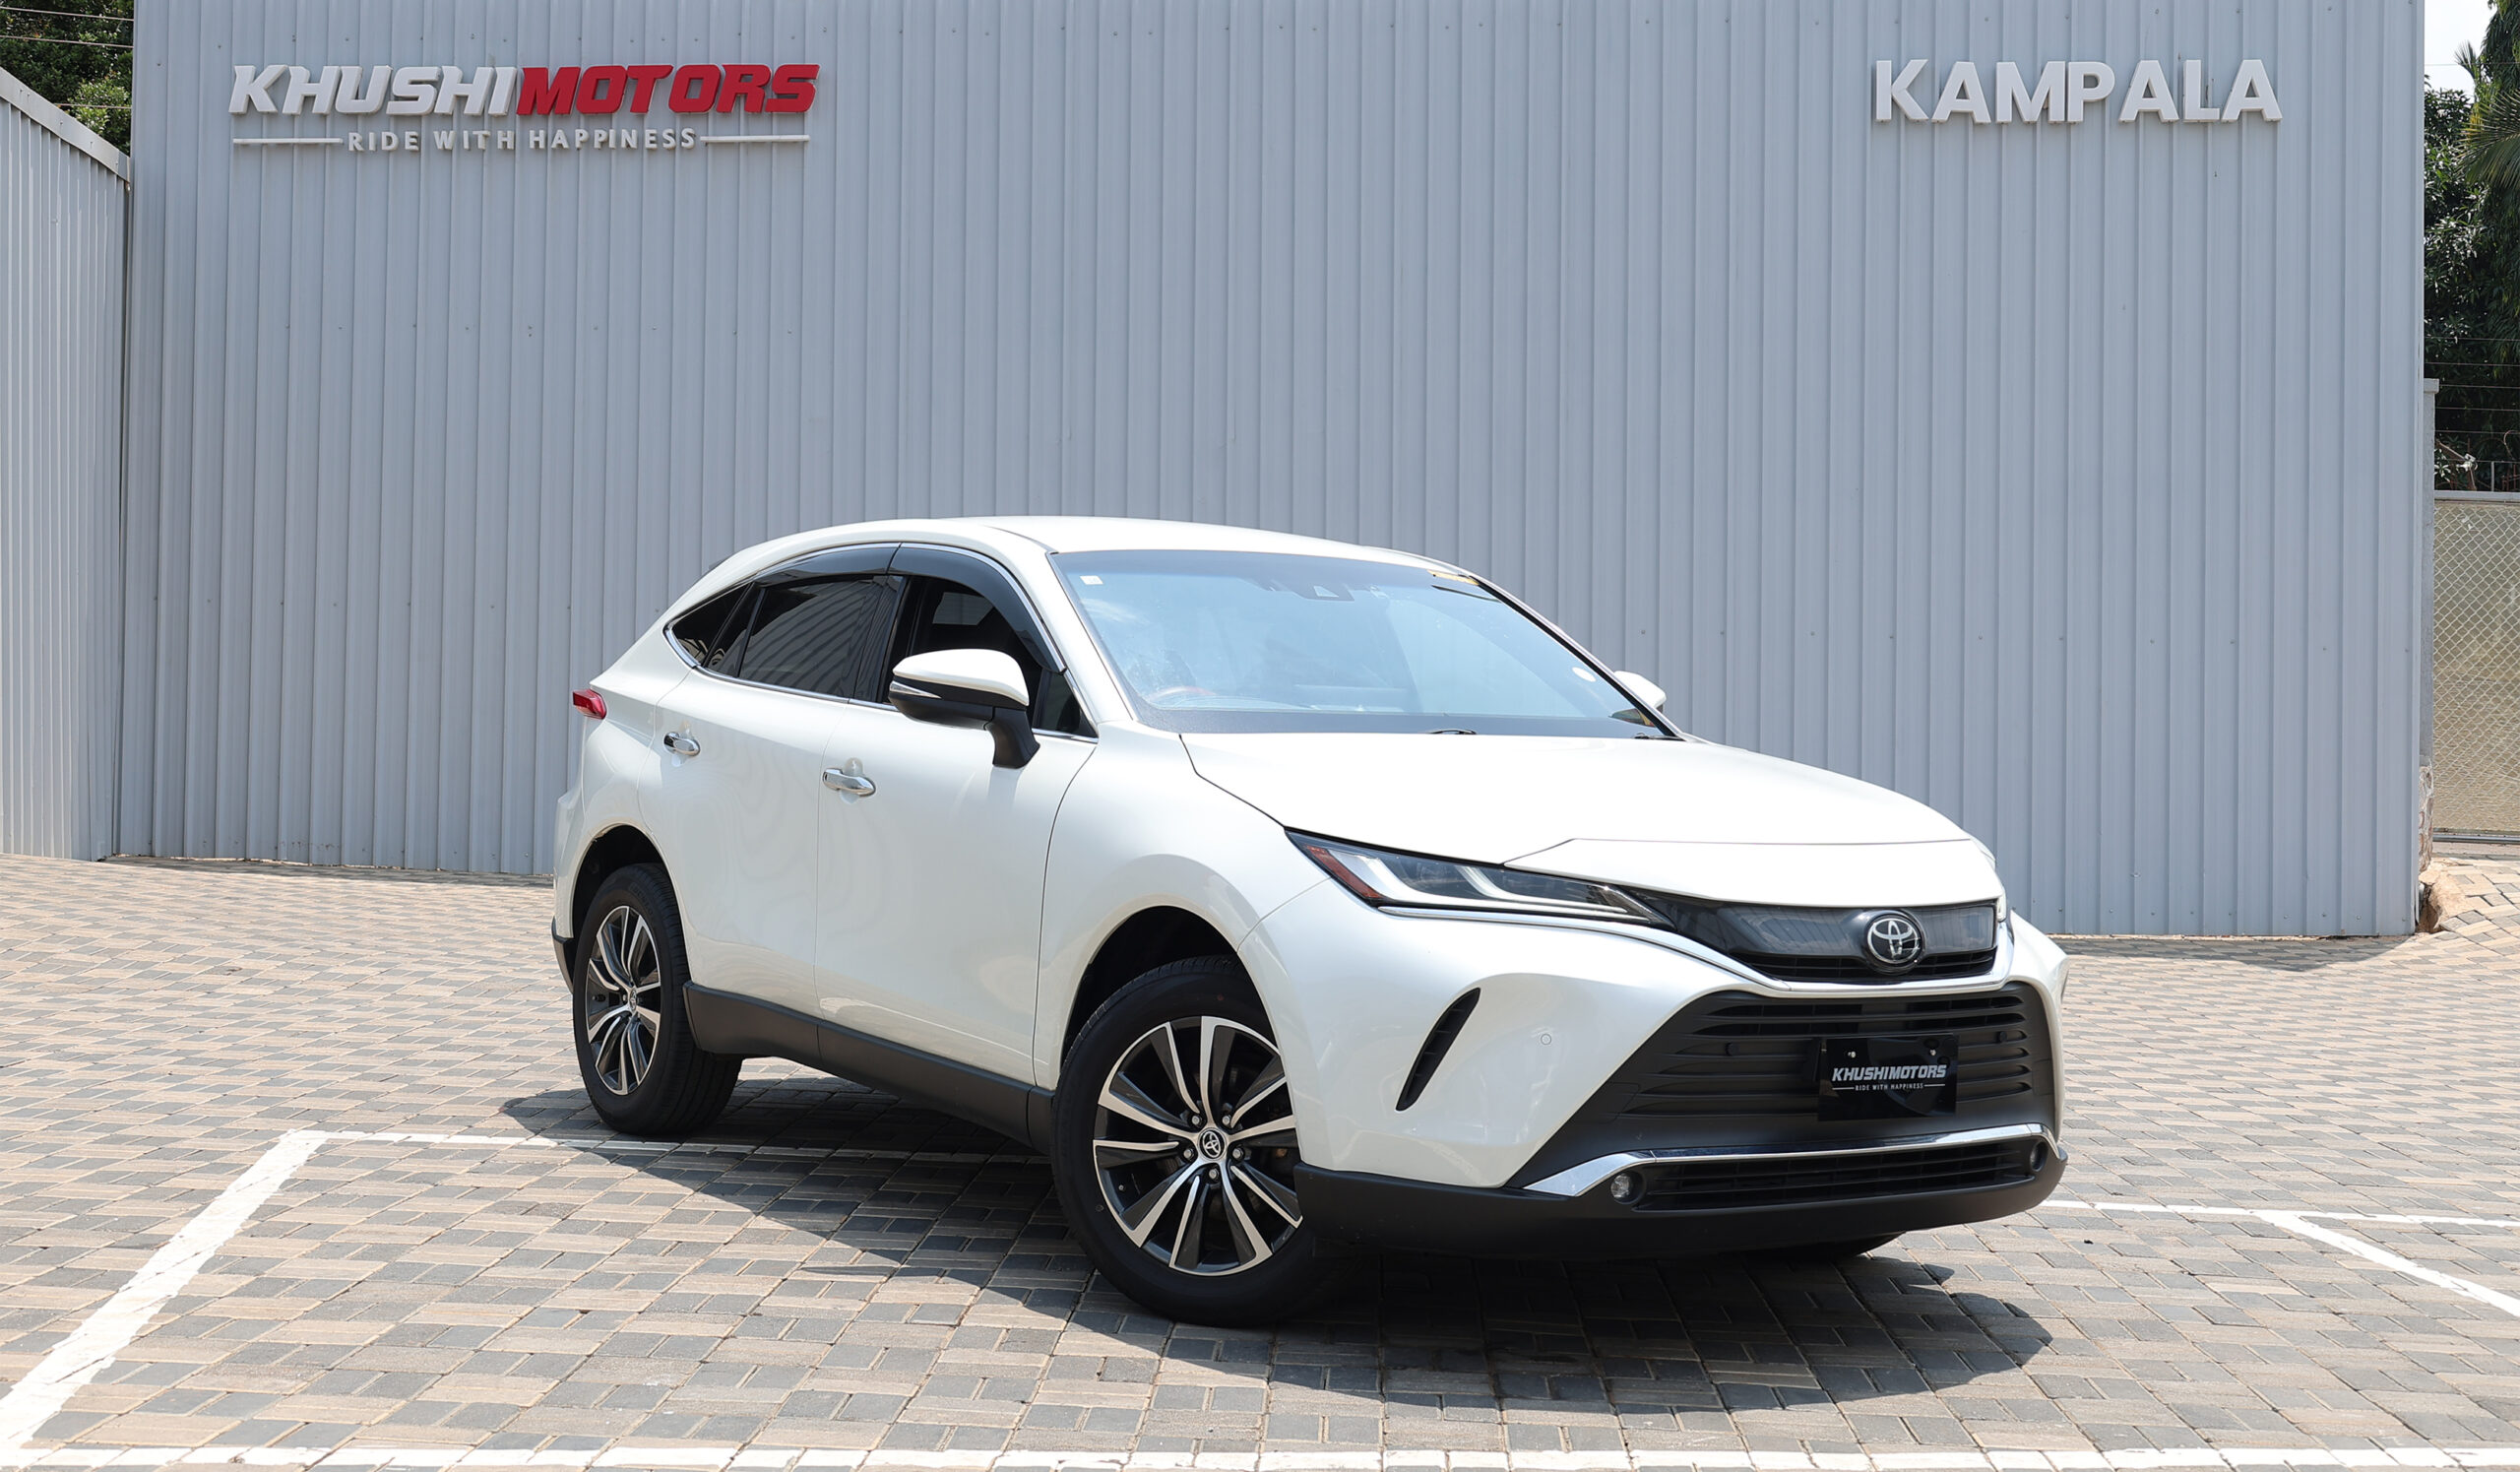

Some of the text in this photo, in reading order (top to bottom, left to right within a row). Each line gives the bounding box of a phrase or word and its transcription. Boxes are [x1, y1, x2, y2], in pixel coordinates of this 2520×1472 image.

[1875, 59, 2283, 124] KAMPALA
[348, 128, 696, 152] RIDE WITH HAPPINESS
